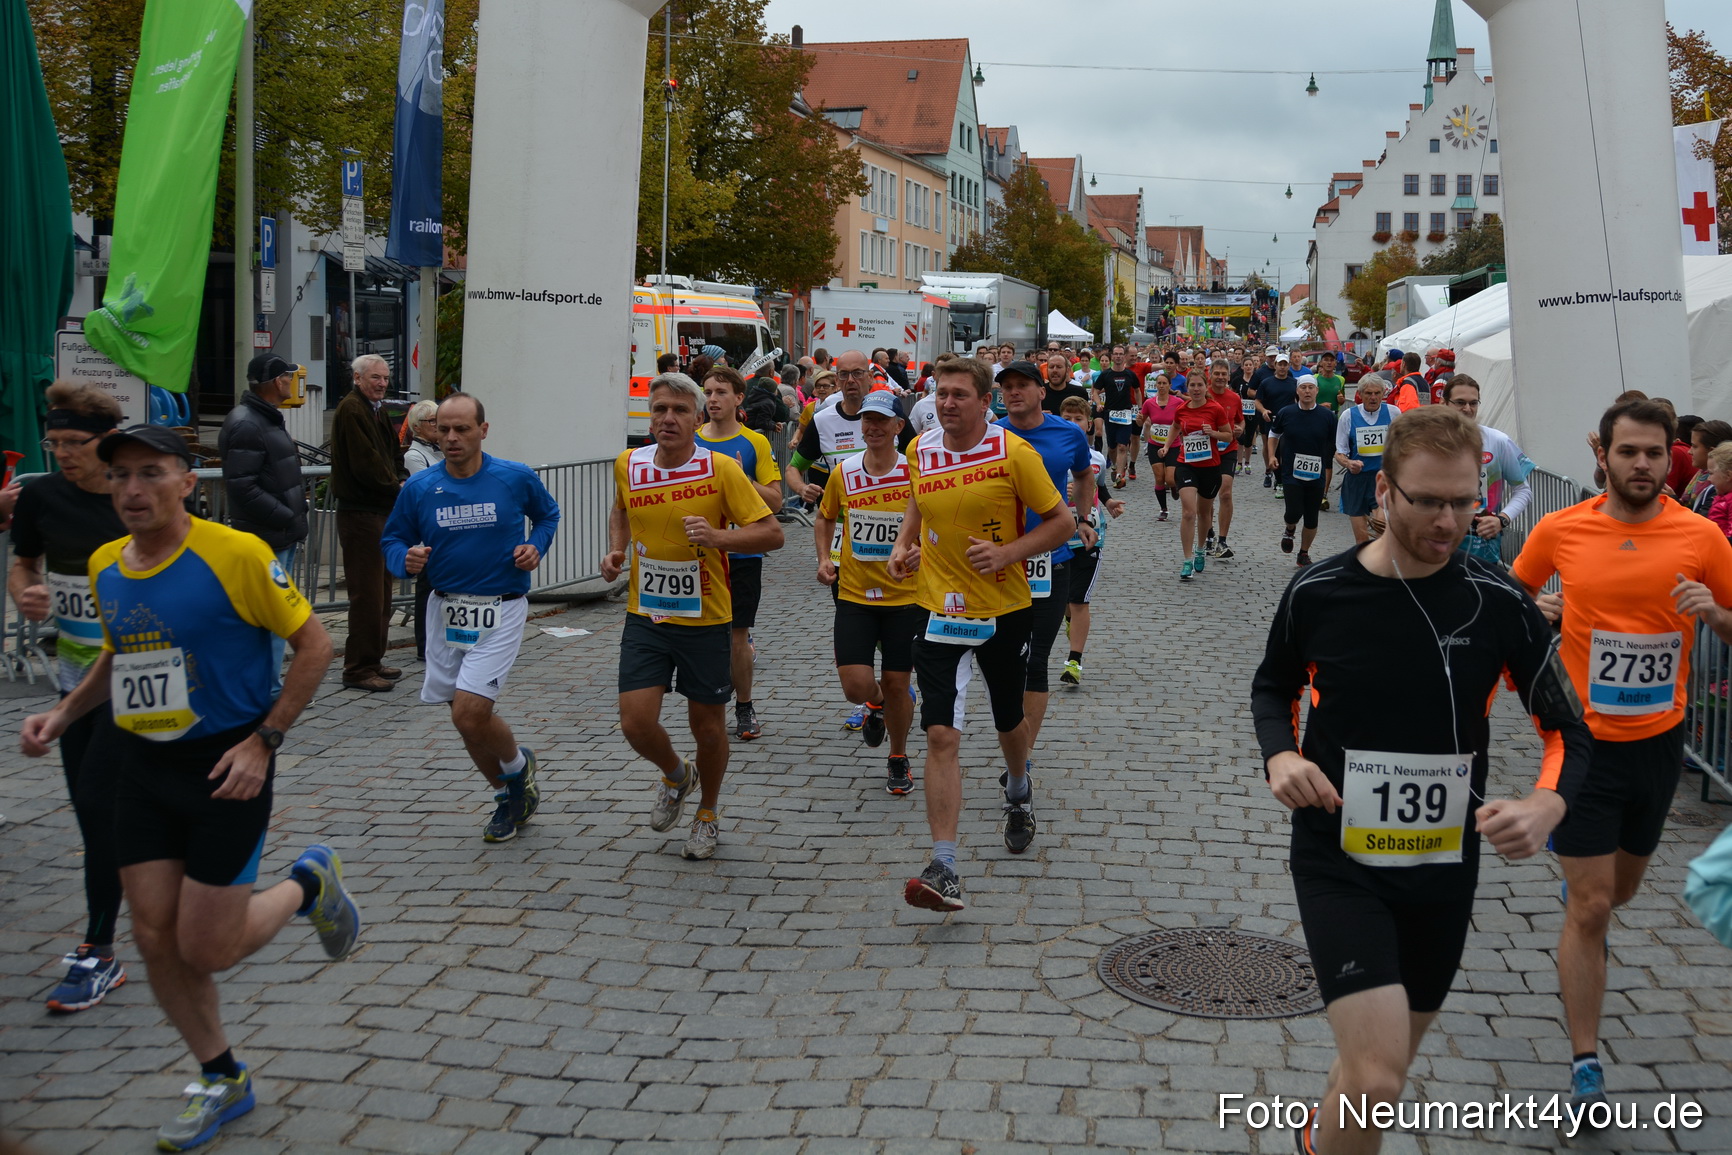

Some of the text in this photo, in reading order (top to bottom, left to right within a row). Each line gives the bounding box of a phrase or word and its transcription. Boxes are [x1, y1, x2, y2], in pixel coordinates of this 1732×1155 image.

[467, 288, 602, 305] www.bmw-laufsport.de
[1538, 288, 1682, 308] www.bmw-laufsport.de
[62, 342, 97, 354] Fußgäng
[72, 367, 112, 378] Kreuzung
[1186, 441, 1208, 452] 2205
[1364, 433, 1383, 445] 521
[1297, 460, 1319, 472] 2618
[918, 466, 1009, 495] MAX BÖGL
[630, 484, 718, 508] MAX BÖGL
[848, 490, 910, 509] MAX BÖG
[436, 503, 496, 520] HUBER
[450, 516, 494, 524] TECHNOLOGY
[853, 522, 898, 542] 2705
[858, 546, 889, 554] Andreas
[640, 561, 657, 571] PARTL
[644, 572, 695, 595] 2799
[658, 600, 679, 609] Josef
[446, 606, 495, 628] 2310
[943, 624, 978, 637] Richard
[1593, 637, 1668, 650] PARTL Neumarkt
[1599, 651, 1673, 684] 2733
[123, 673, 168, 709] 207
[1349, 762, 1452, 777] PARTL Neumarkt
[1372, 782, 1447, 823] 139
[1366, 834, 1442, 850] Sebastian
